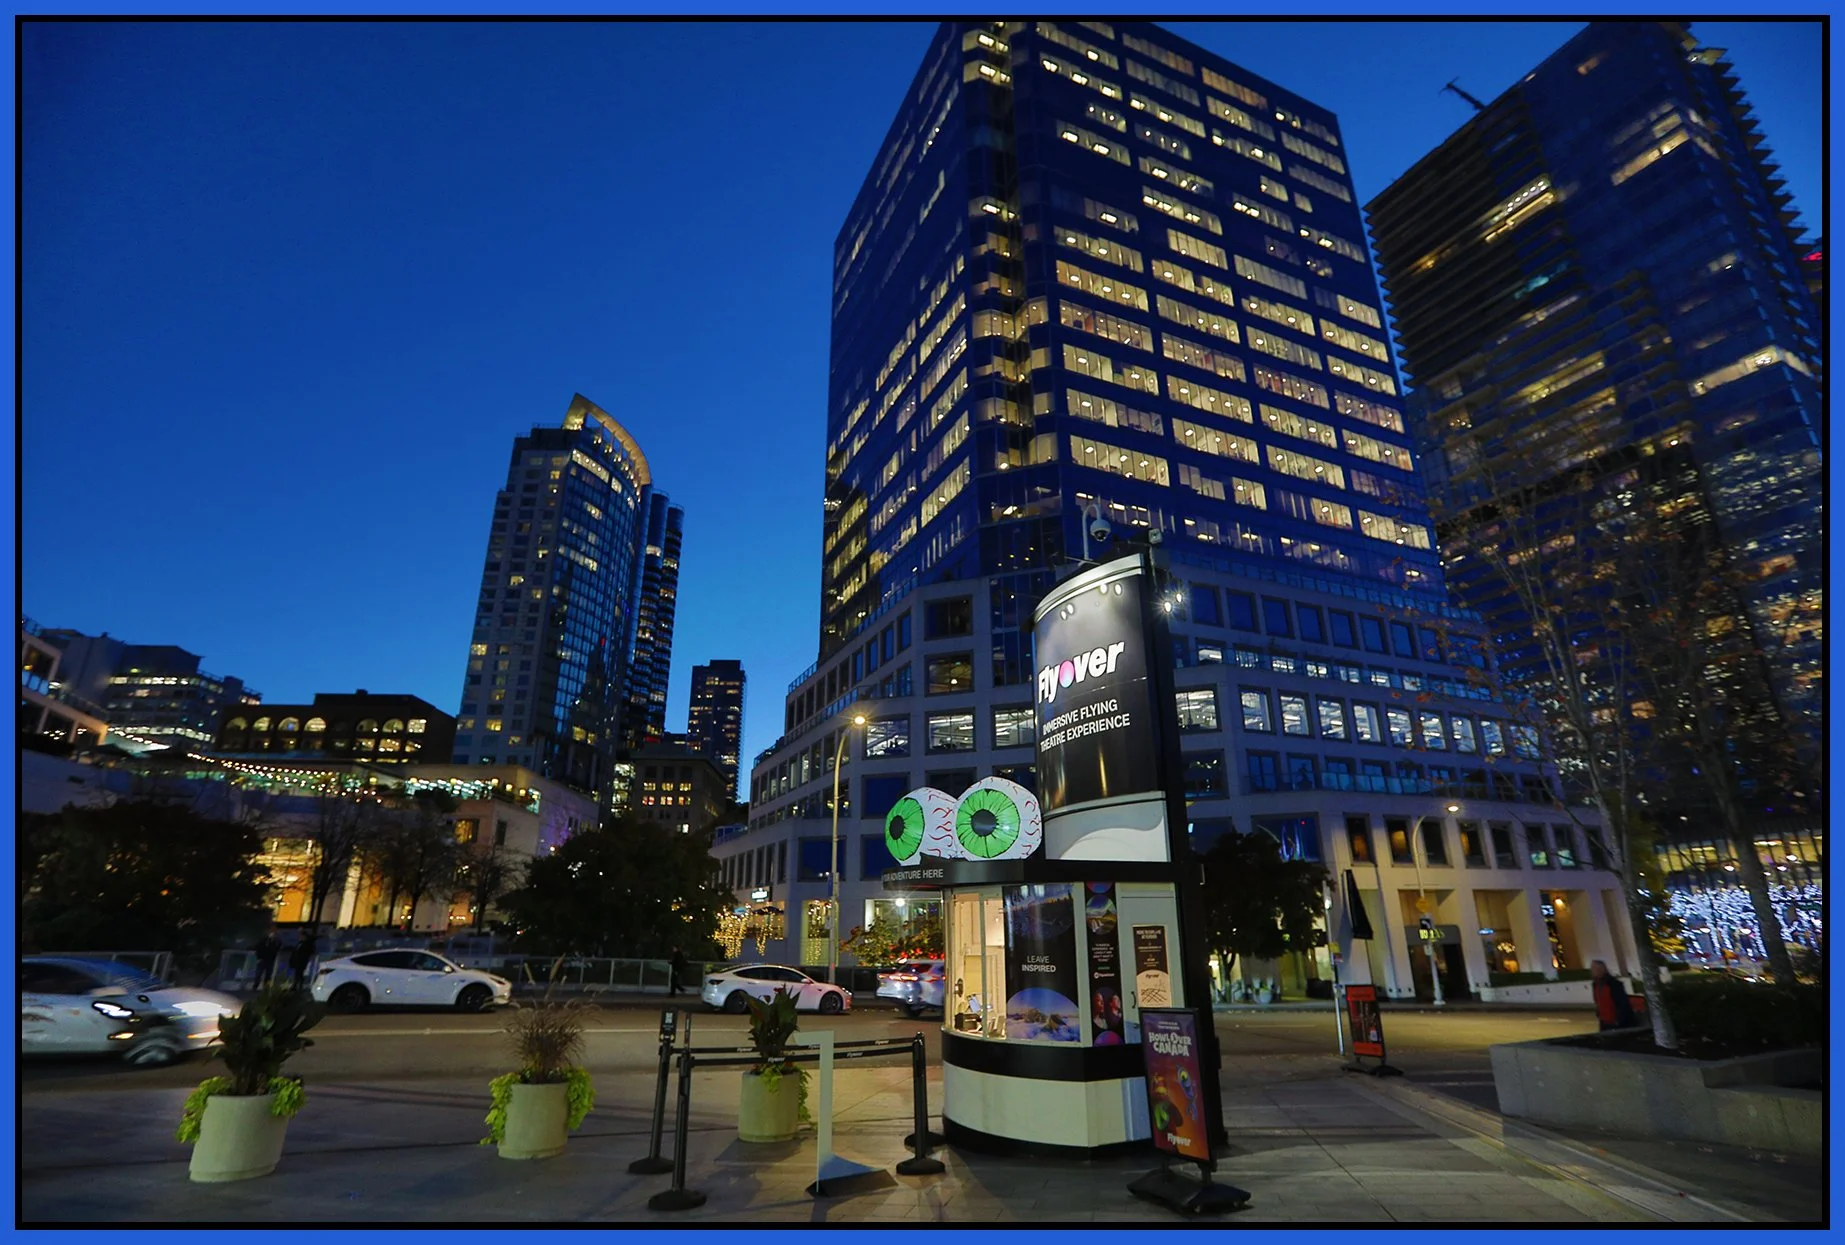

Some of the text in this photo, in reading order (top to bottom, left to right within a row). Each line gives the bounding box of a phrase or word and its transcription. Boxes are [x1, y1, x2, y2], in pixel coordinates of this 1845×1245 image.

[1038, 641, 1125, 703] Flyover
[1043, 699, 1118, 735] IMMERSIVE FLYING
[1040, 713, 1131, 752] THEATRE EXPERIENCE
[890, 869, 921, 881] ADVENTURE
[922, 868, 944, 879] HERE
[1027, 955, 1050, 964] LEAVE
[1022, 964, 1057, 973] INSPIRED
[1153, 1041, 1190, 1056] CANADA
[1167, 1132, 1191, 1147] Flyover
